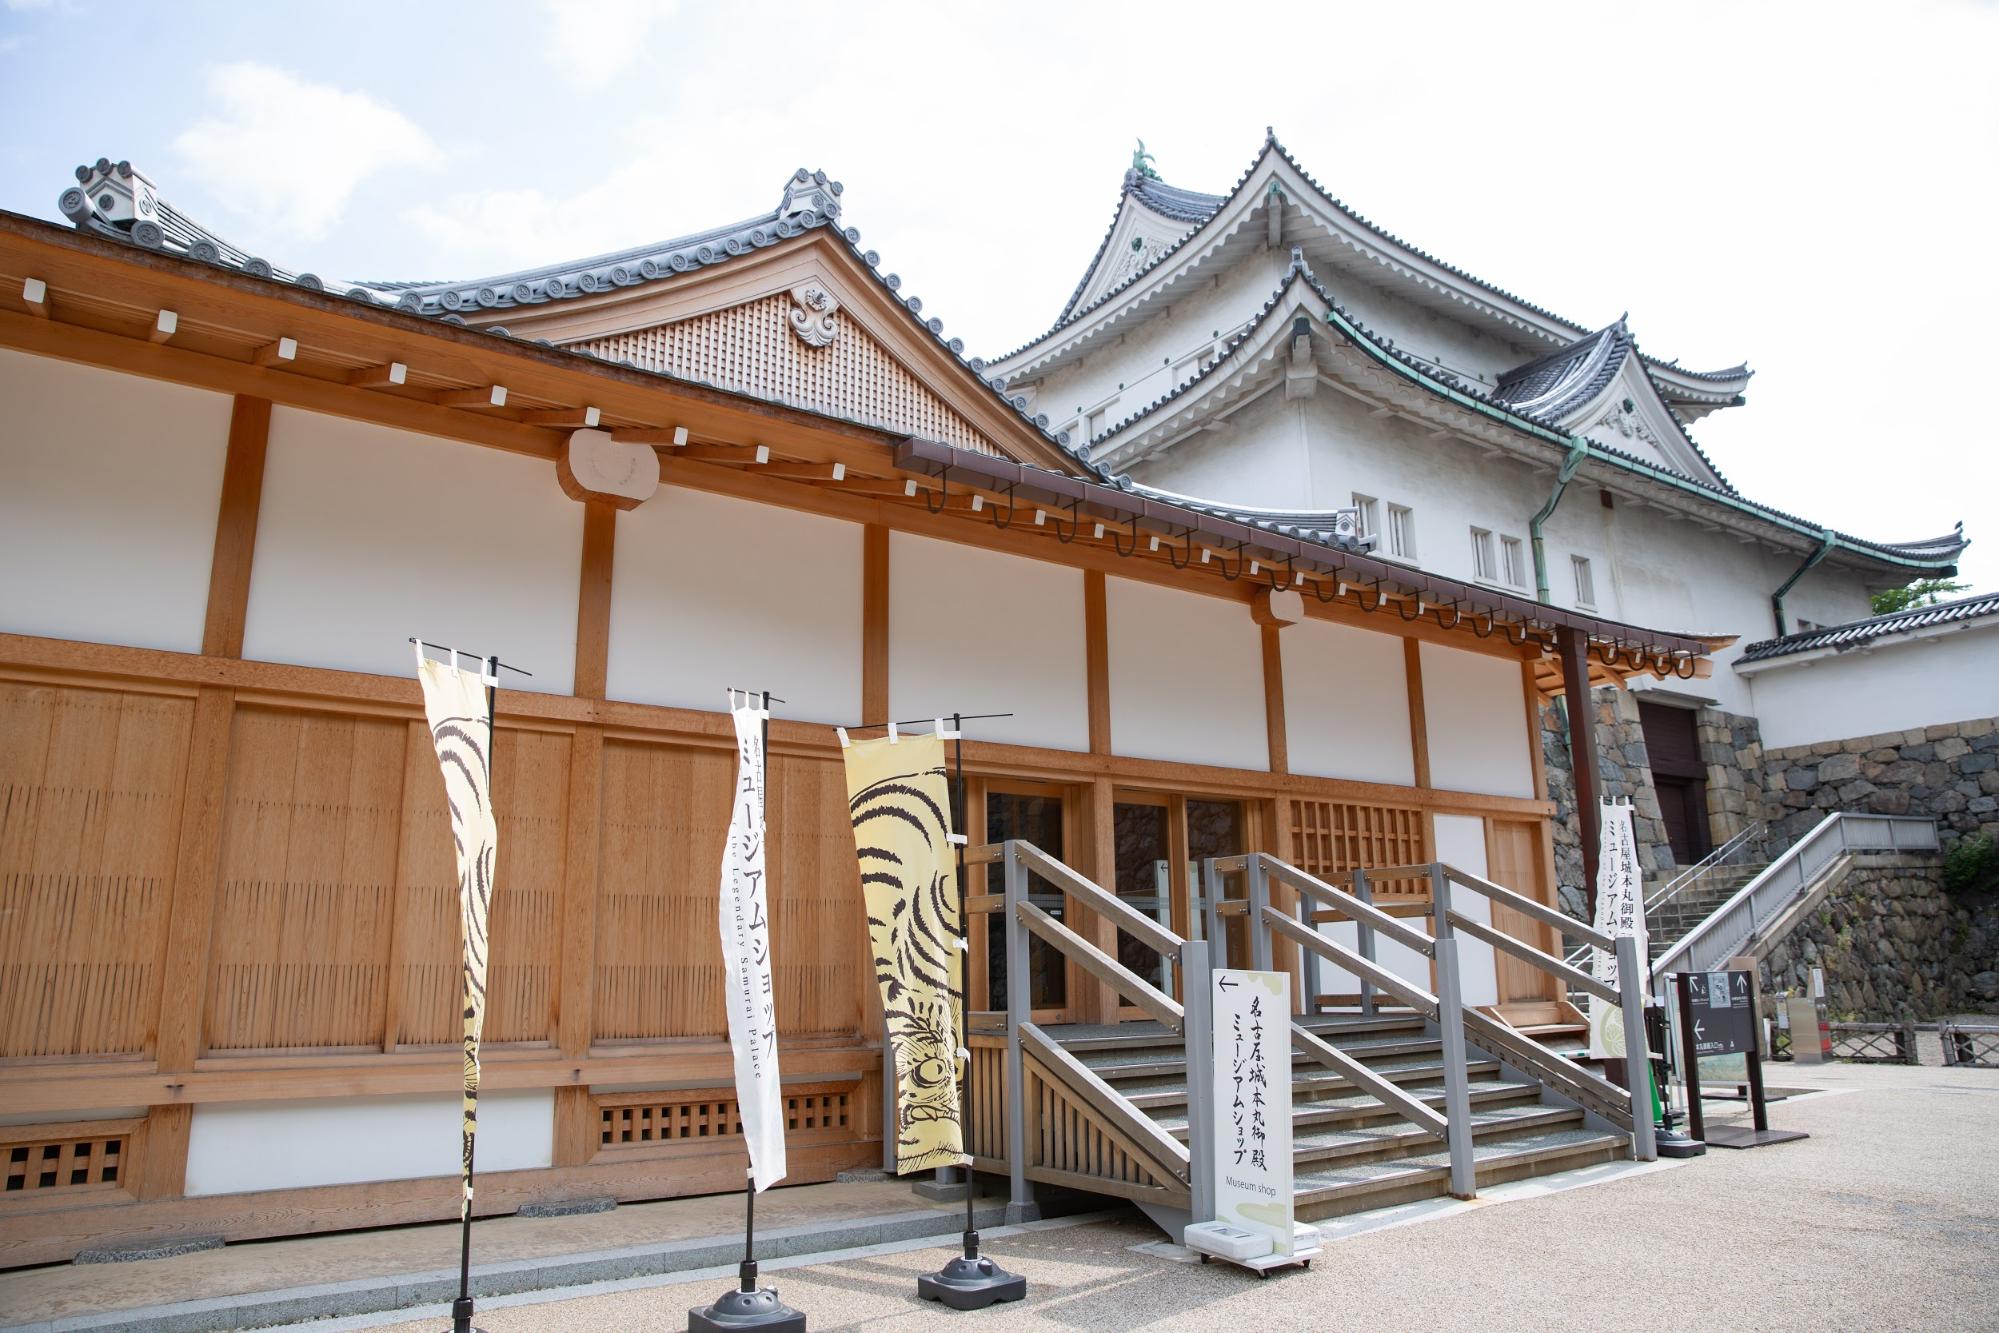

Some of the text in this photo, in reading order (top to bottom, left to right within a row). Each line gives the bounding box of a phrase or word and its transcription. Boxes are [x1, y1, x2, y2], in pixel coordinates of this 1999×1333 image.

[743, 738, 775, 1058] ミュージアムショップ
[1620, 820, 1634, 936] 名古屋城本丸御殿
[732, 868, 745, 948] Legendary
[741, 957, 755, 1019] Samurai
[749, 1028, 762, 1079] Palace
[1232, 1013, 1247, 1165] ミュージアムショップ
[1249, 996, 1267, 1171] 名古屋城本丸御殿
[1225, 1175, 1277, 1197] Museum shop
